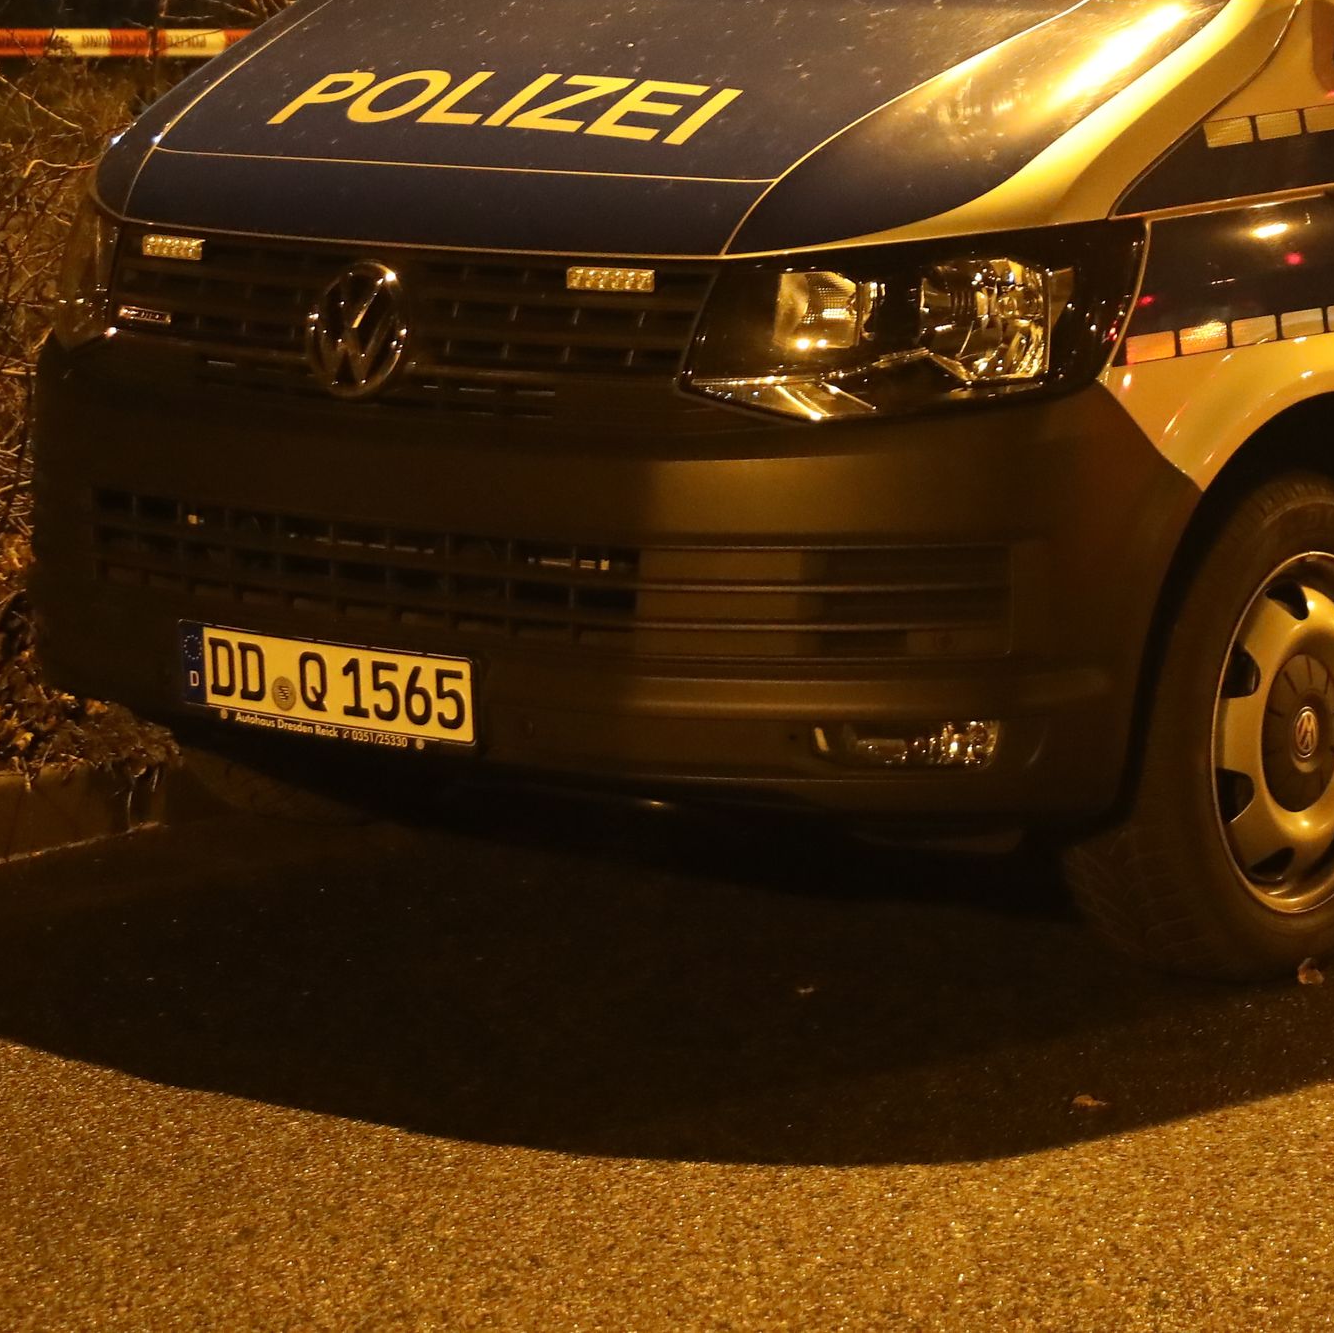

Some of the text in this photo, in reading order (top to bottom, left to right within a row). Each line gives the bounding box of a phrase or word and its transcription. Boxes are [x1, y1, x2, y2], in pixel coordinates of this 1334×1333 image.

[266, 69, 745, 146] POLIZEI
[190, 669, 201, 688] D
[208, 636, 467, 730] DD Q 1565
[234, 712, 276, 729] Autohaus
[277, 717, 314, 734] Dresden
[315, 724, 339, 739] Reick
